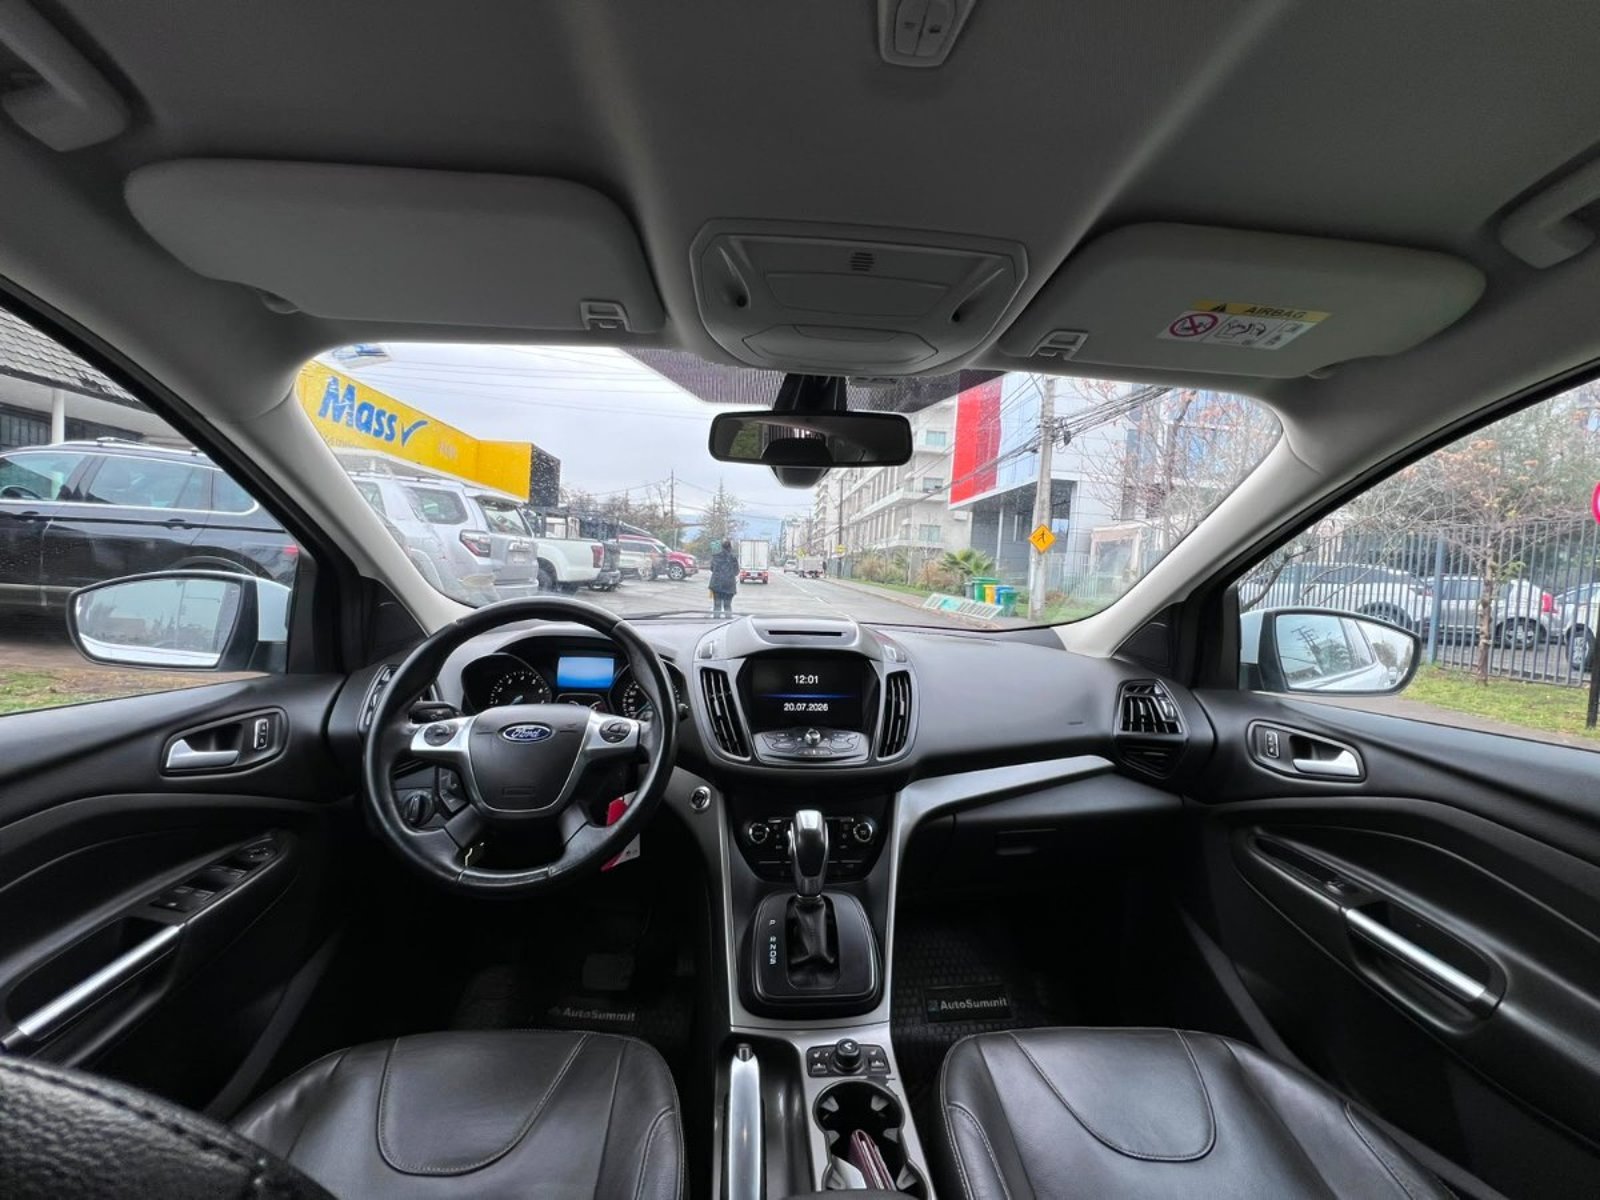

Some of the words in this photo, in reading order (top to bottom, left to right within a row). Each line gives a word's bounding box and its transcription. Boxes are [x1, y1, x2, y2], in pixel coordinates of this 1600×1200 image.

[1244, 306, 1307, 318] AIRBAG
[318, 375, 398, 442] Mass
[794, 674, 819, 684] 12:01
[510, 726, 541, 739] Ford
[940, 997, 1008, 1010] AutoSummit
[563, 1007, 636, 1022] AutoSummit
